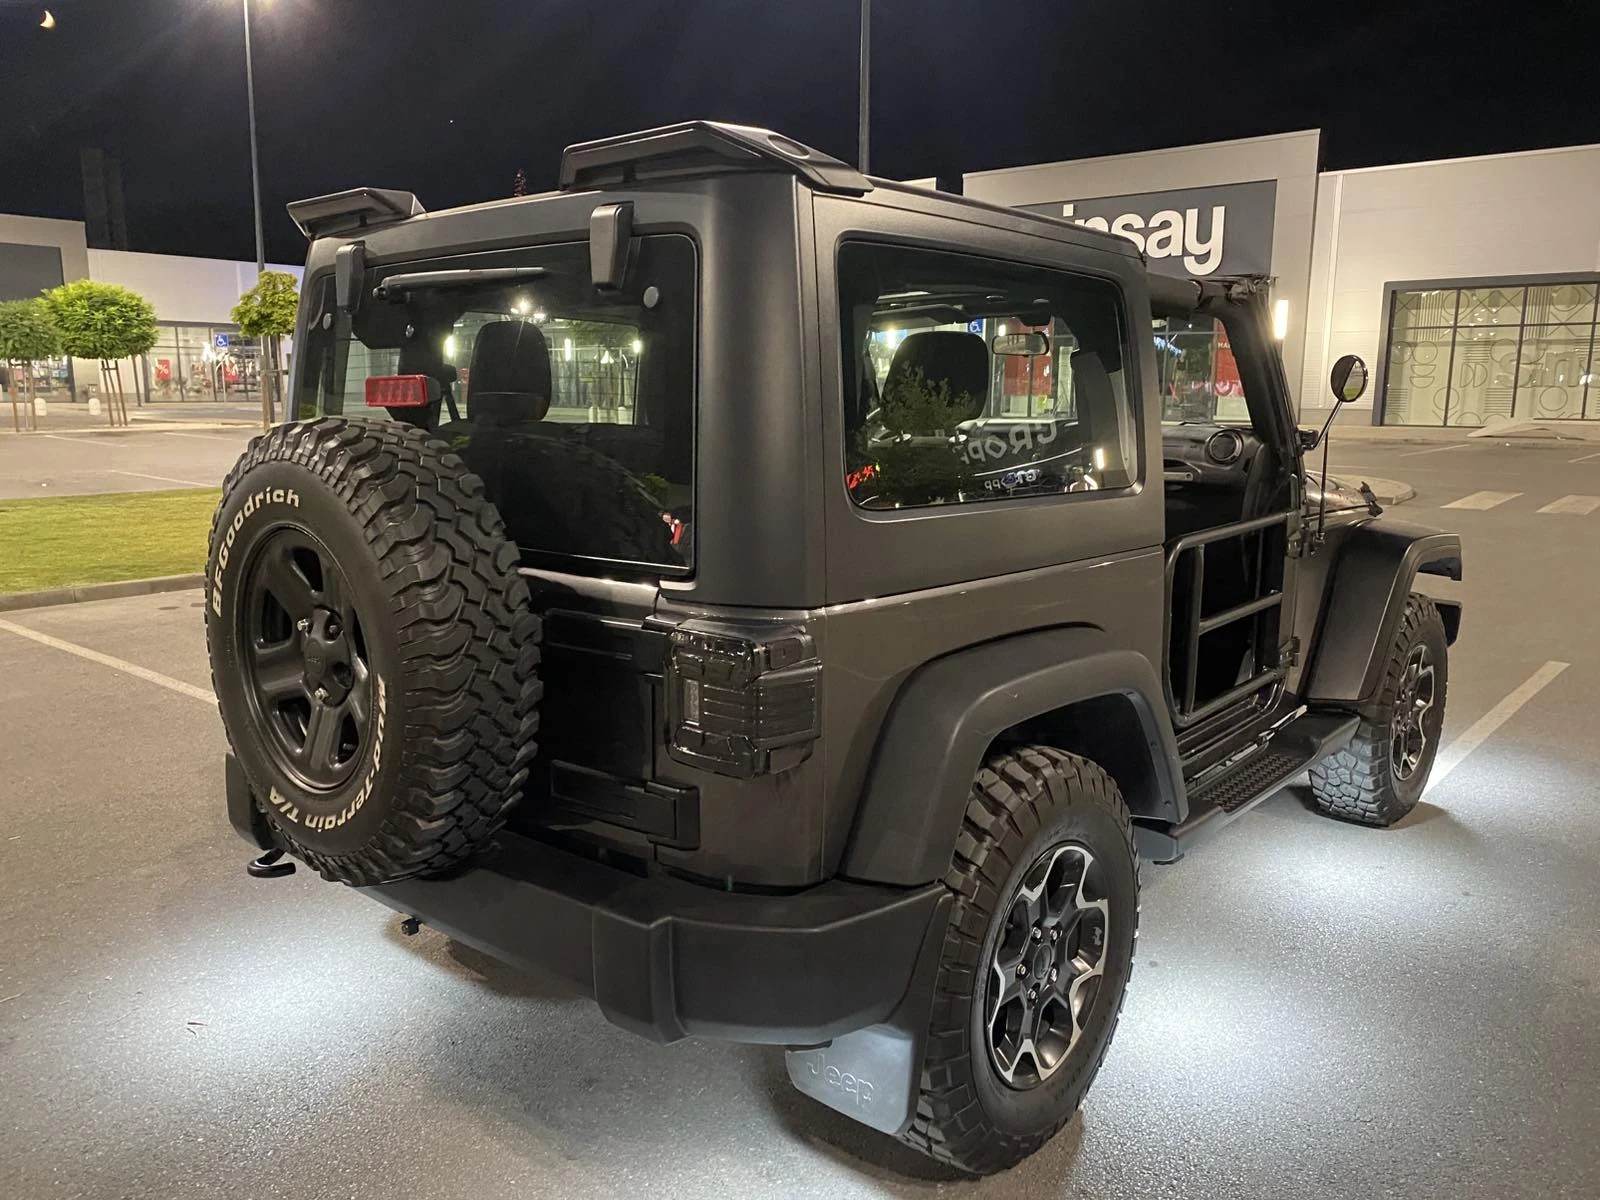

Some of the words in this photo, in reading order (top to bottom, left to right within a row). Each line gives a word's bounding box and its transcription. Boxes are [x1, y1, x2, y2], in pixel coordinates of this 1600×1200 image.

[212, 486, 300, 618] BFGoodrich
[305, 673, 386, 832] Mud-Terrain
[269, 785, 299, 823] T/A
[806, 1053, 875, 1109] Jeep
